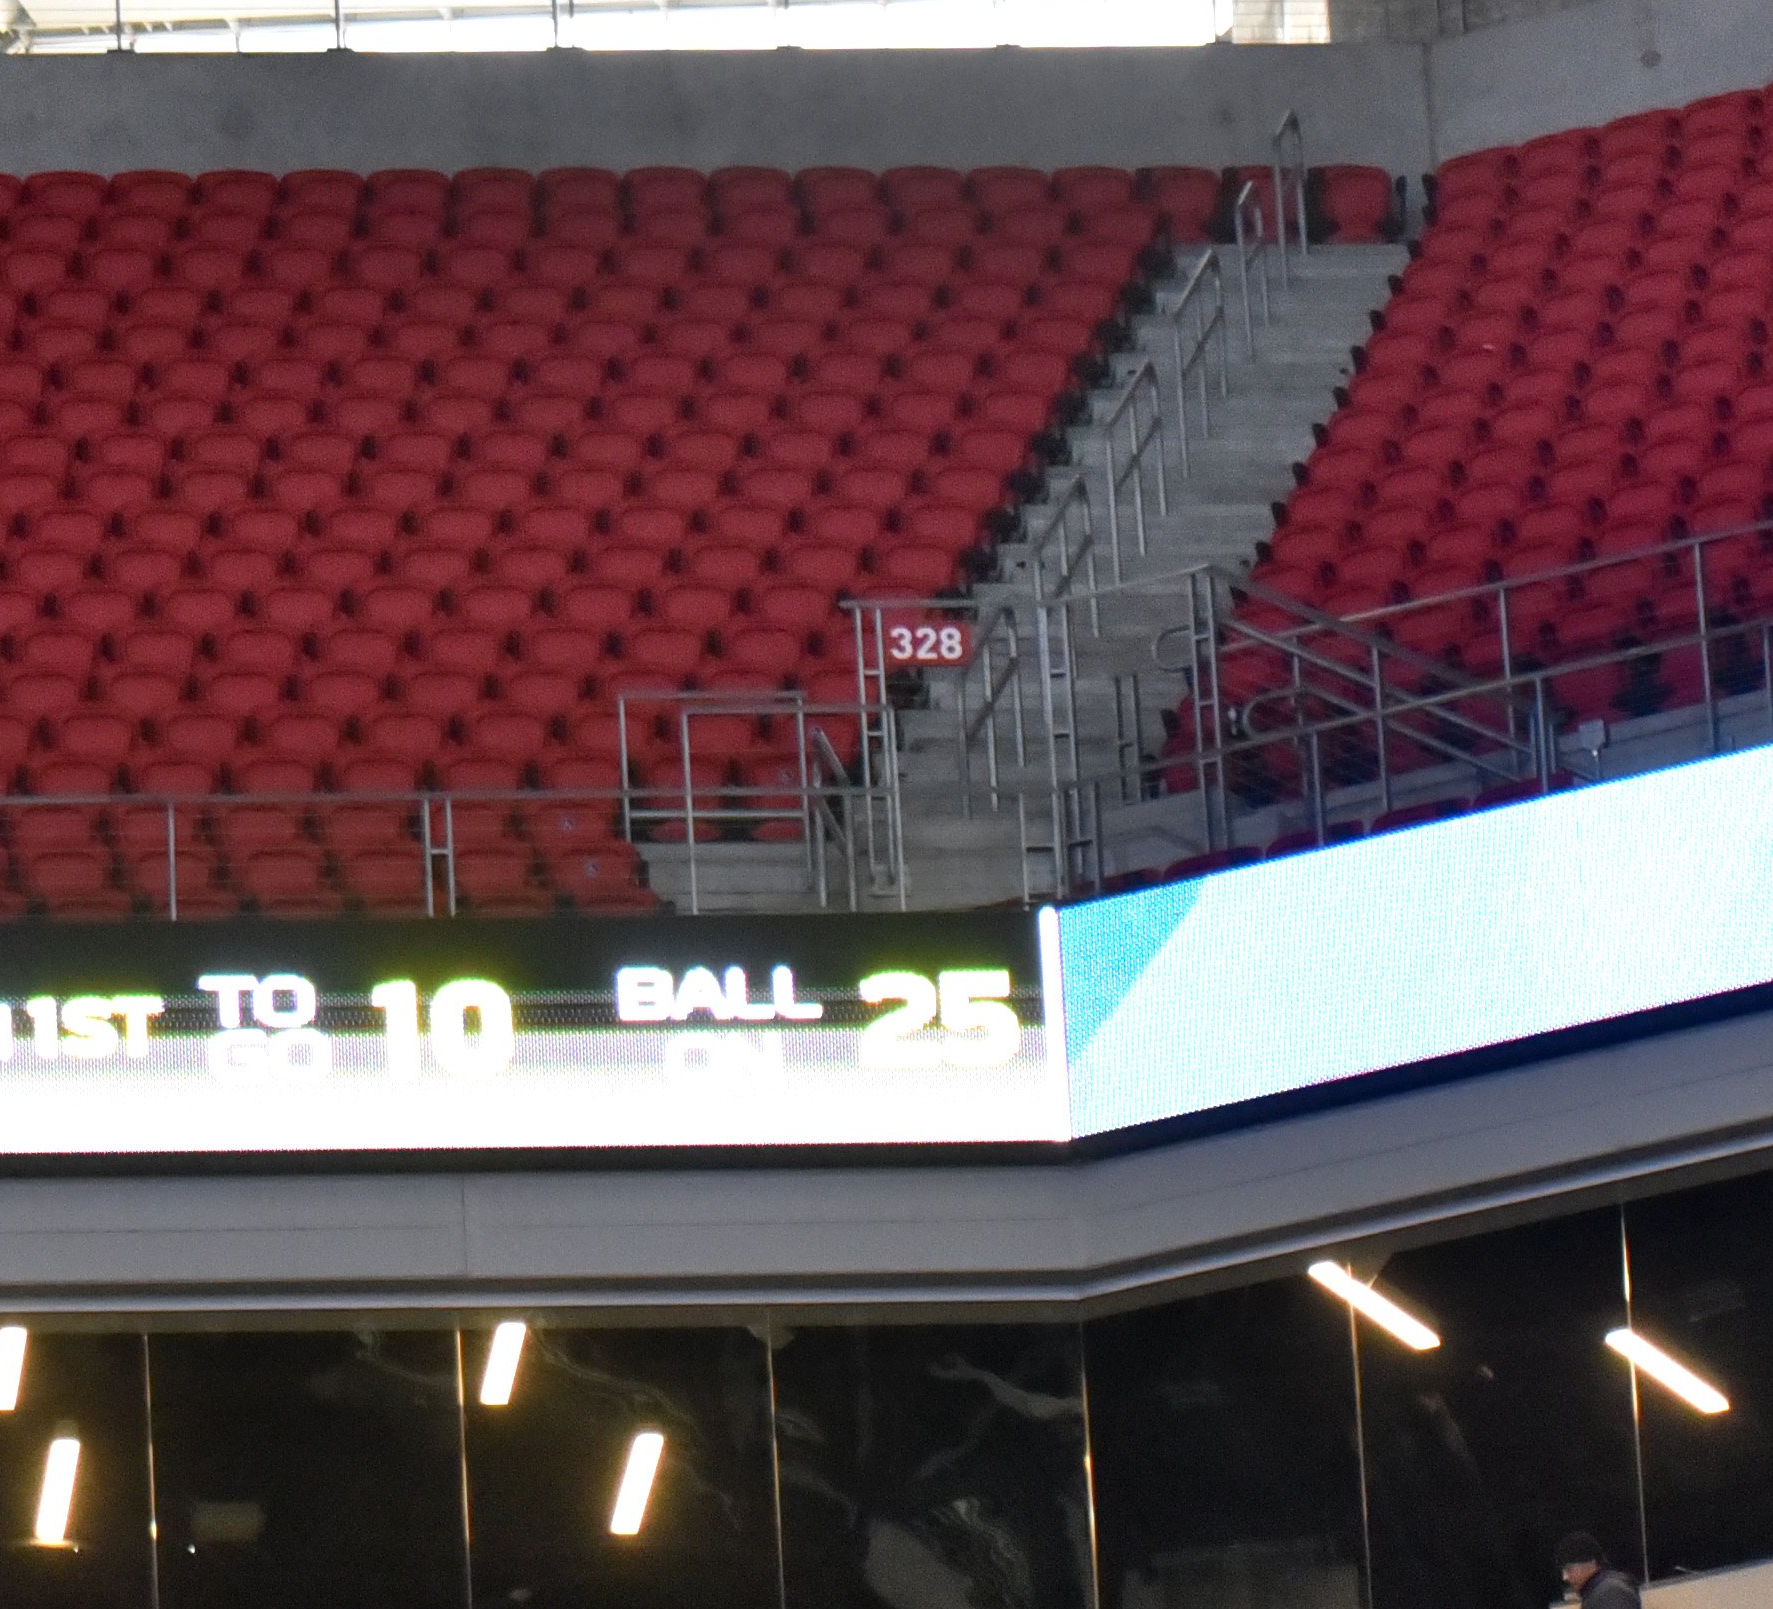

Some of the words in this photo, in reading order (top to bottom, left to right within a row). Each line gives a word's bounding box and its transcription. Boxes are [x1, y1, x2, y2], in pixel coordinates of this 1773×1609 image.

[890, 626, 963, 660] 328
[199, 974, 316, 1029] TO
[617, 966, 823, 1022] BALL
[857, 969, 1021, 1069] 25
[27, 994, 164, 1059] 1ST
[371, 978, 515, 1078] 10
